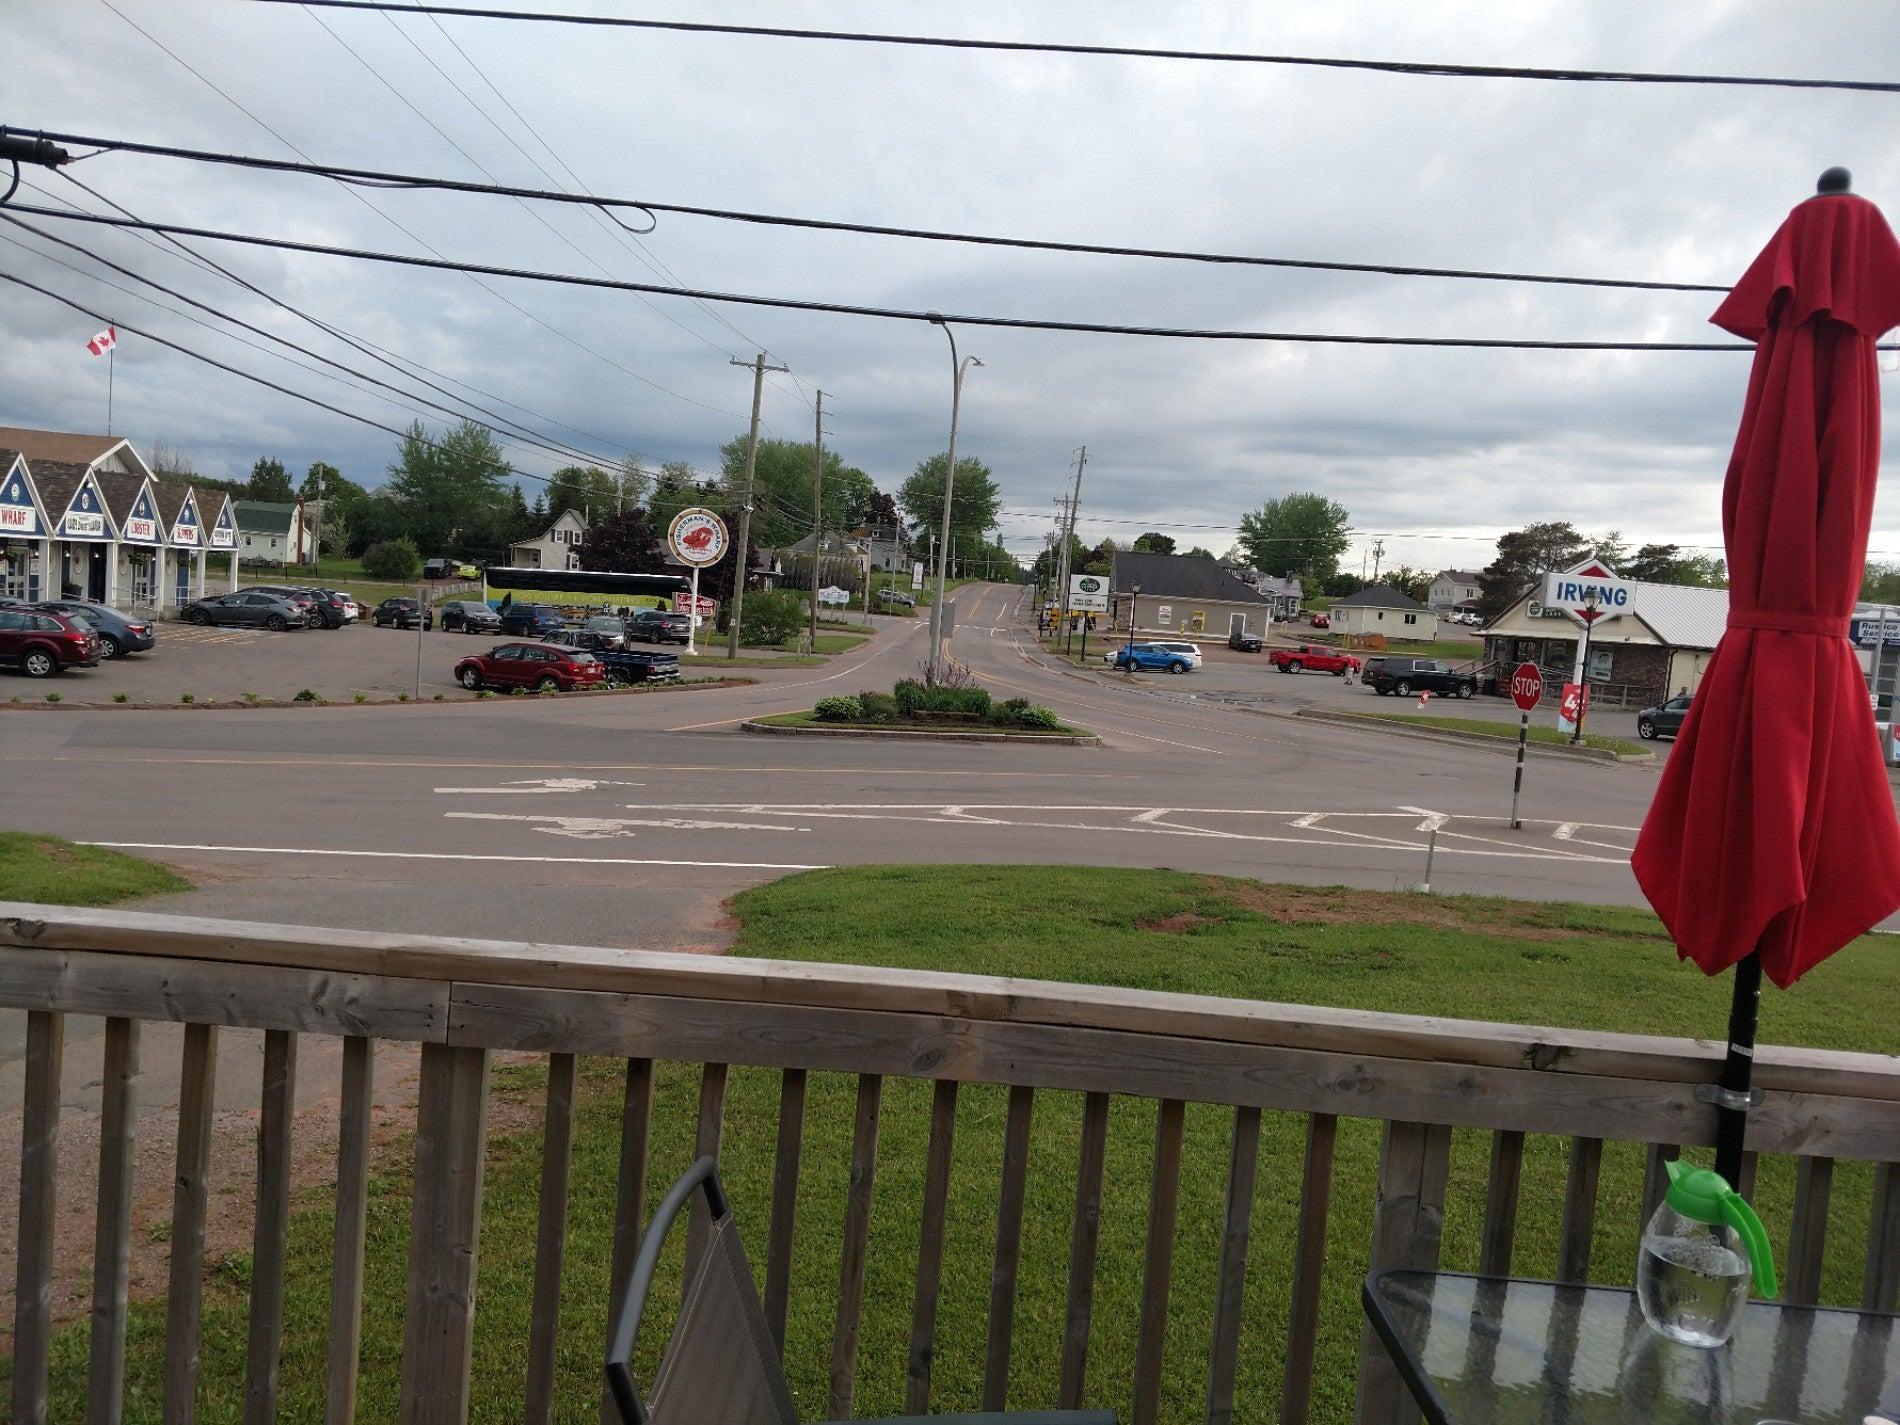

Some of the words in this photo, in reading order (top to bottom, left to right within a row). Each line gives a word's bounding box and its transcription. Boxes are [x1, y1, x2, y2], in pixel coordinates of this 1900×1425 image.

[1, 509, 26, 526] WHARF
[1556, 581, 1628, 606] IRVNG
[1861, 622, 1898, 631] Rusico
[1862, 630, 1899, 638] Serice
[1513, 676, 1540, 698] STOP
